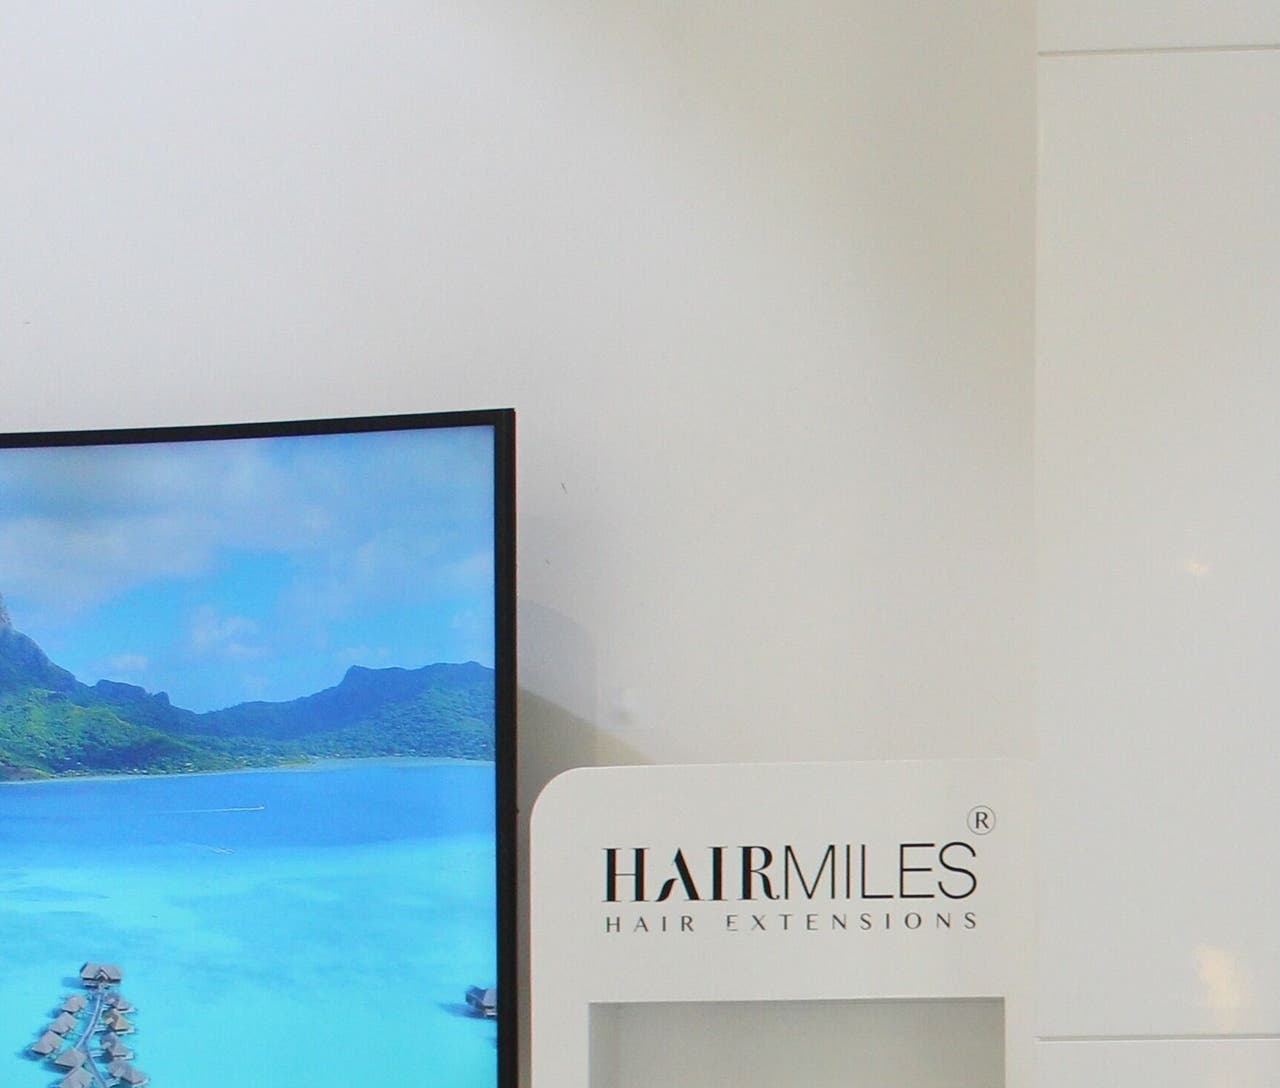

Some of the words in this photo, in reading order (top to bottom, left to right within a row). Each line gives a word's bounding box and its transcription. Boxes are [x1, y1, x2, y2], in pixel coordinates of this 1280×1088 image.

[601, 841, 978, 902] HAIRMILES
[605, 914, 696, 933] HAIR
[725, 911, 978, 931] EXTENSIONS
